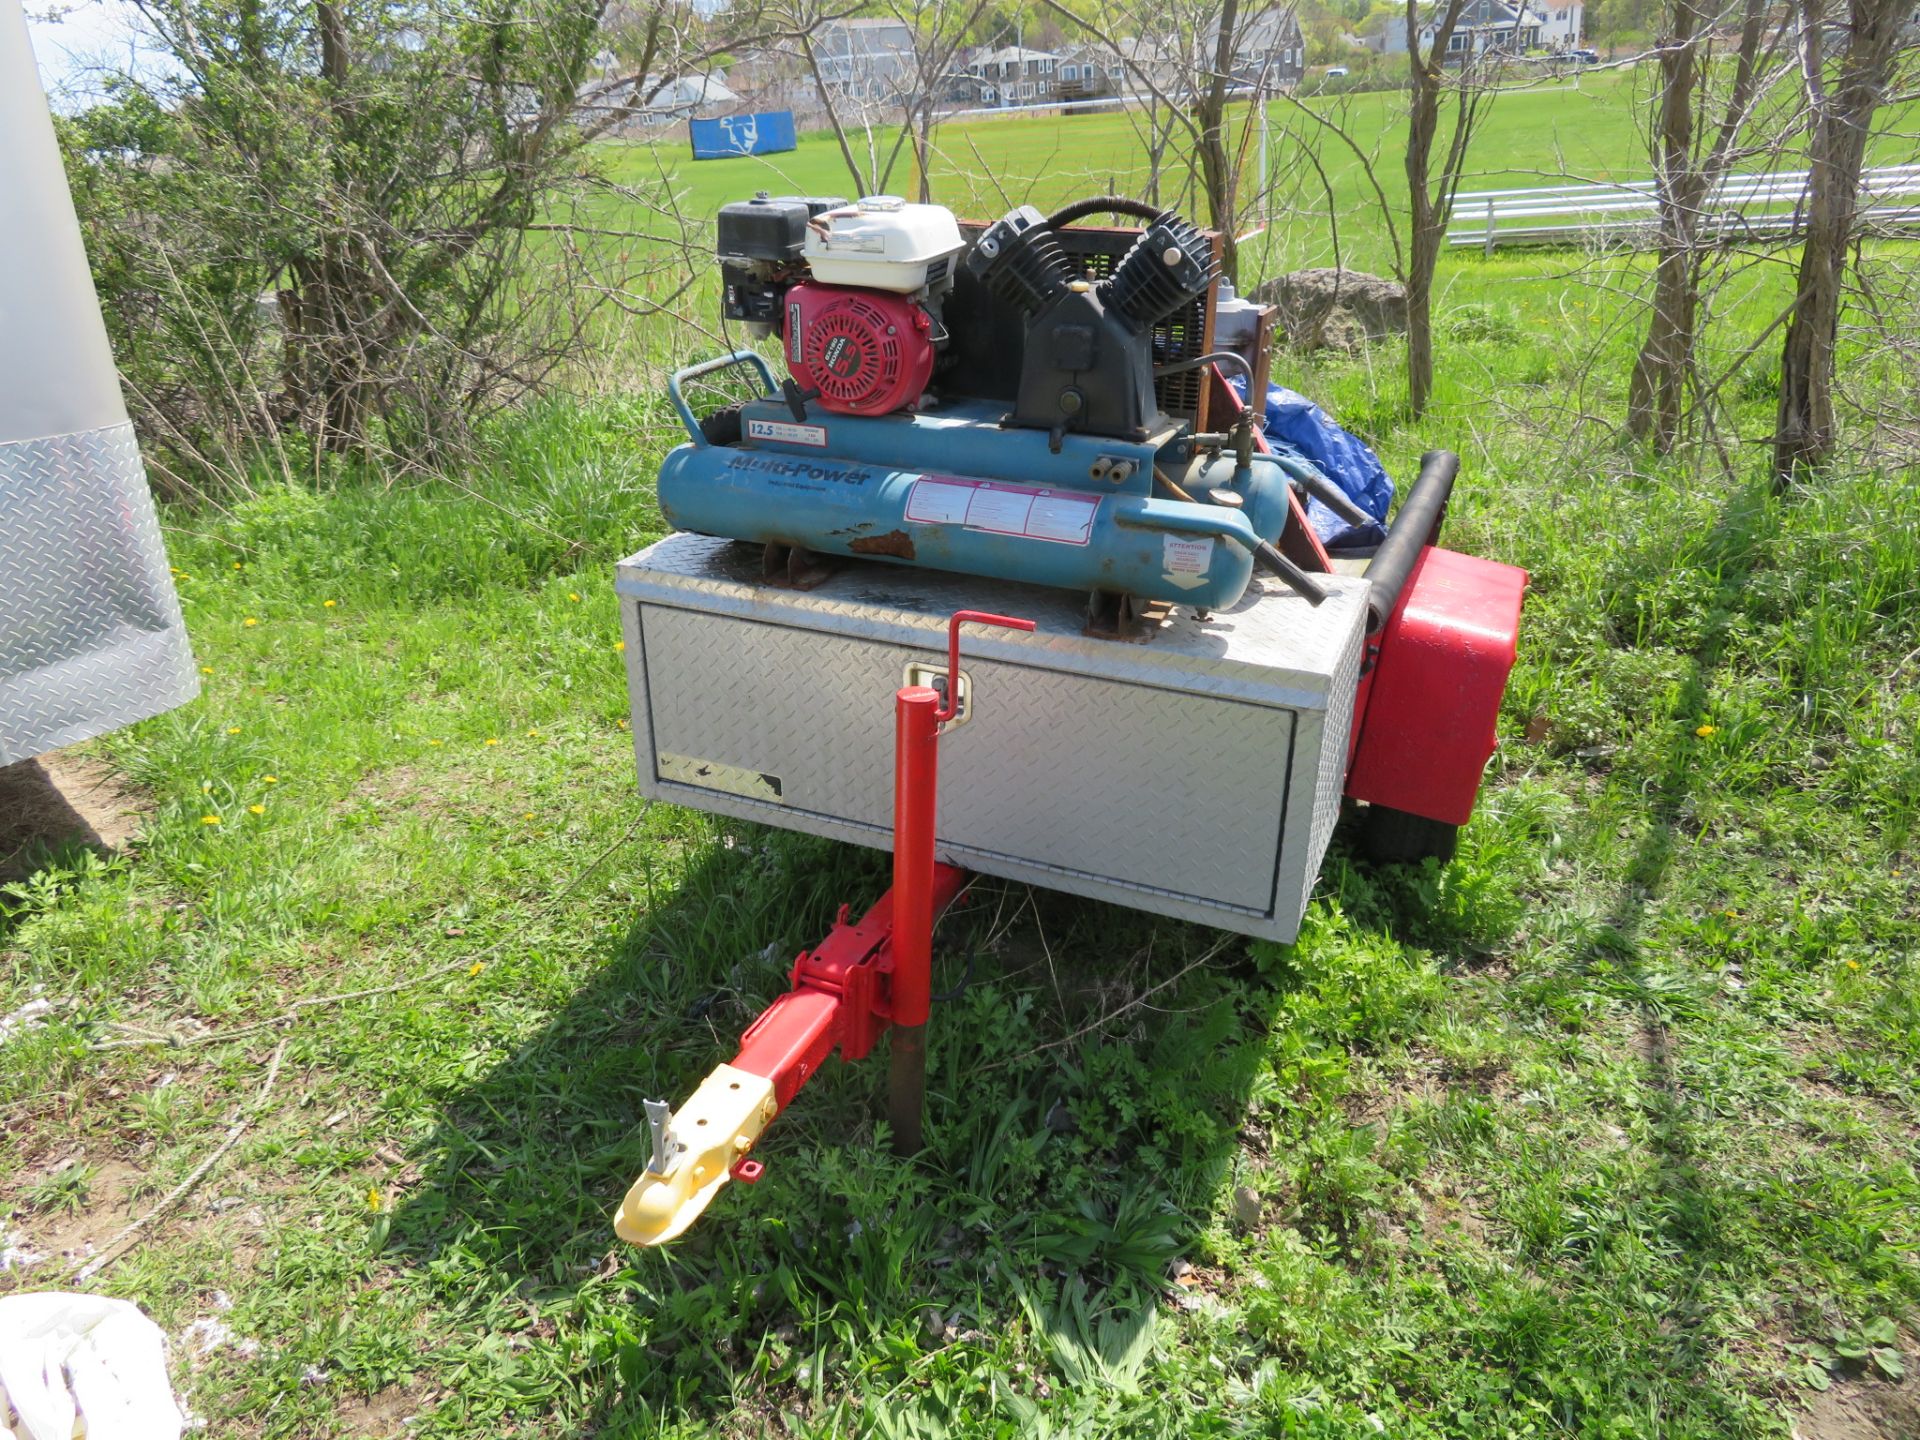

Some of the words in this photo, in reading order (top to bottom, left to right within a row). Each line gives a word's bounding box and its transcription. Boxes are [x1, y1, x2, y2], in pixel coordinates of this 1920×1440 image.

[828, 337, 847, 369] HONDA
[751, 423, 774, 436] 12.5
[727, 456, 871, 486] Multi-Power
[1169, 543, 1208, 551] ATTENTION
